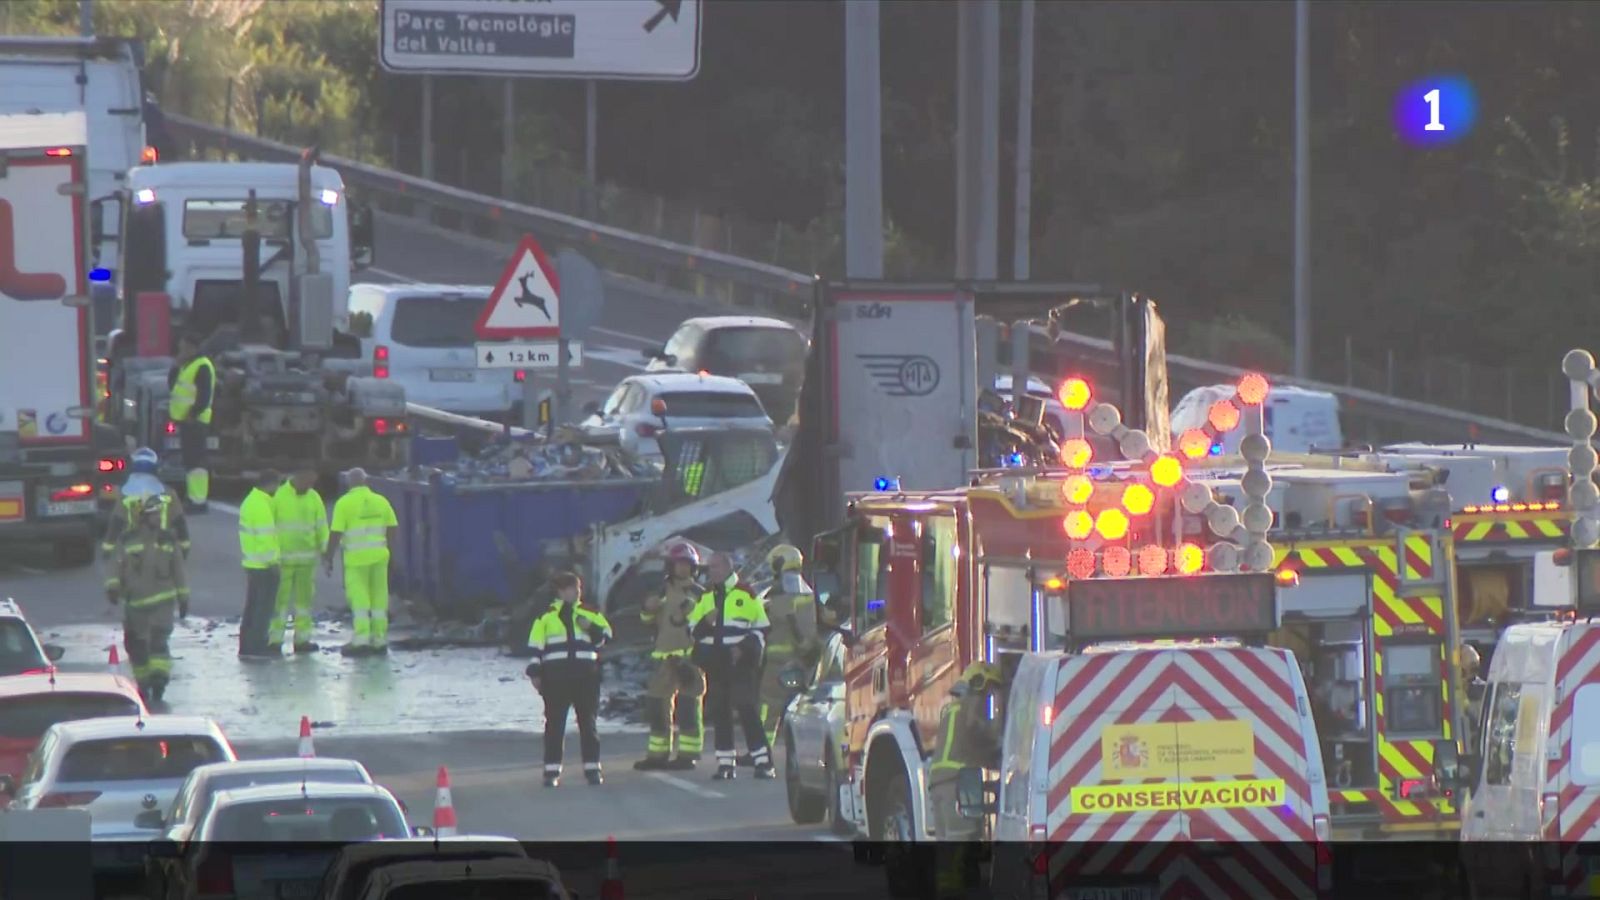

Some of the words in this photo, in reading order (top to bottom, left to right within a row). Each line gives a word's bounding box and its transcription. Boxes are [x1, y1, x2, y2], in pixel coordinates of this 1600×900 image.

[396, 12, 445, 31] Parc
[397, 36, 427, 51] del
[527, 349, 550, 362] km
[1080, 783, 1277, 810] CONSERVACIÓN
